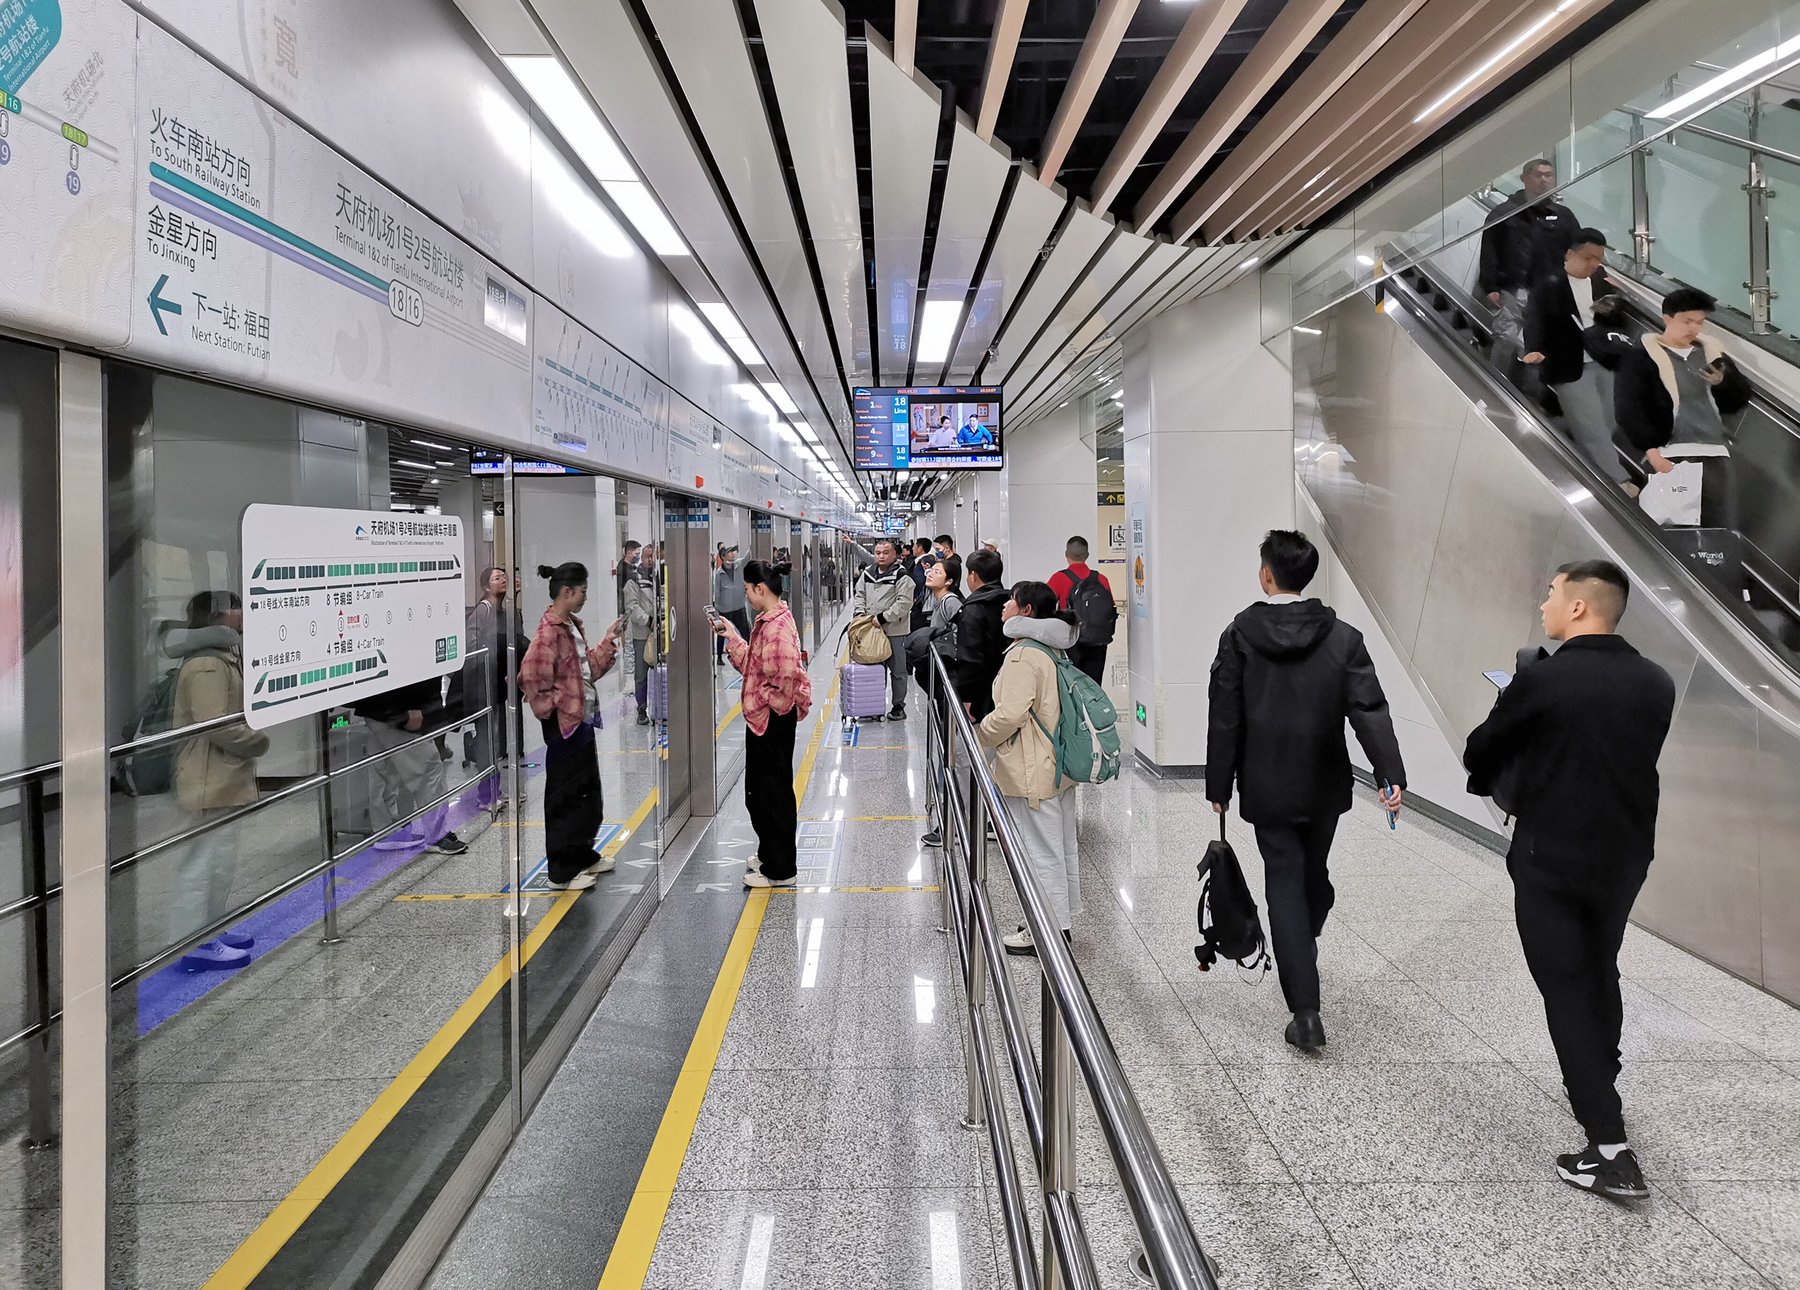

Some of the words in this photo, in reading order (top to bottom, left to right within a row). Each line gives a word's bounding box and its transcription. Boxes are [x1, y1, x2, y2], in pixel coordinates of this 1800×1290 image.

[3, 57, 23, 81] Terminal
[8, 58, 35, 91] International
[35, 40, 51, 62] Airport
[8, 98, 18, 109] 16
[150, 107, 251, 188] 火车南站方向
[67, 175, 79, 192] 19
[150, 139, 162, 158] To
[164, 146, 193, 171] South
[195, 159, 230, 196] Railway
[230, 181, 261, 210] Station
[147, 205, 218, 261] 金星方向
[335, 182, 465, 291] 天府机场1号2号航站楼
[147, 237, 159, 256] To
[160, 242, 196, 272] Jinxing
[335, 225, 367, 256] Terminal
[367, 244, 380, 265] 1&2
[381, 251, 390, 268] of
[390, 256, 410, 279] Tianfu
[410, 266, 446, 299] International
[446, 289, 464, 310] Airport
[391, 286, 404, 313] 18
[408, 295, 420, 320] 16
[191, 325, 212, 346] Next
[213, 332, 246, 355] Station:
[247, 341, 271, 361] Futian
[894, 397, 906, 406] 18
[870, 450, 876, 458] 9
[260, 596, 310, 610] 18号线火车南站方向
[356, 590, 371, 601] 8-Car
[371, 588, 384, 599] Train
[356, 638, 372, 650] 4-Car
[372, 637, 385, 648] Train
